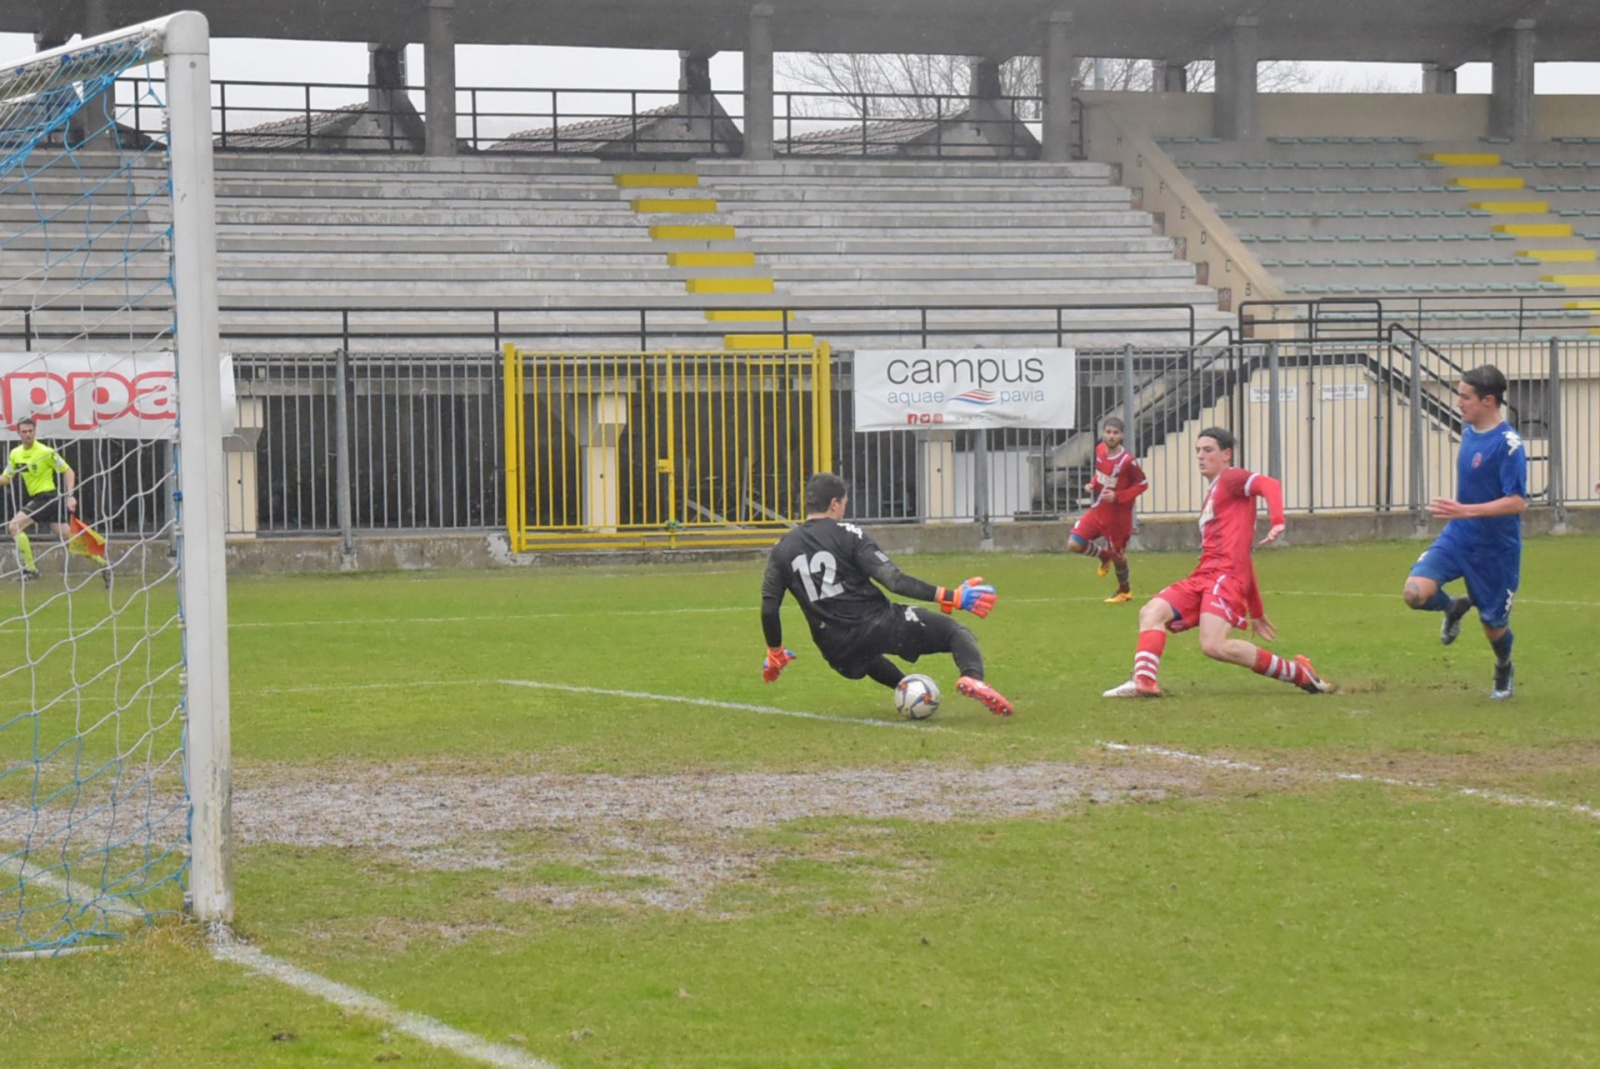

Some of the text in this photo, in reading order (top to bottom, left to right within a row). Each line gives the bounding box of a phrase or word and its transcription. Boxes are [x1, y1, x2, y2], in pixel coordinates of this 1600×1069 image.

[1181, 205, 1186, 220] E
[1201, 231, 1207, 245] D
[1225, 259, 1231, 273] C
[1245, 282, 1251, 296] B
[887, 358, 1044, 389] campus
[0, 371, 177, 430] ppa
[887, 388, 1045, 407] aquae pavia
[791, 550, 844, 602] 12
